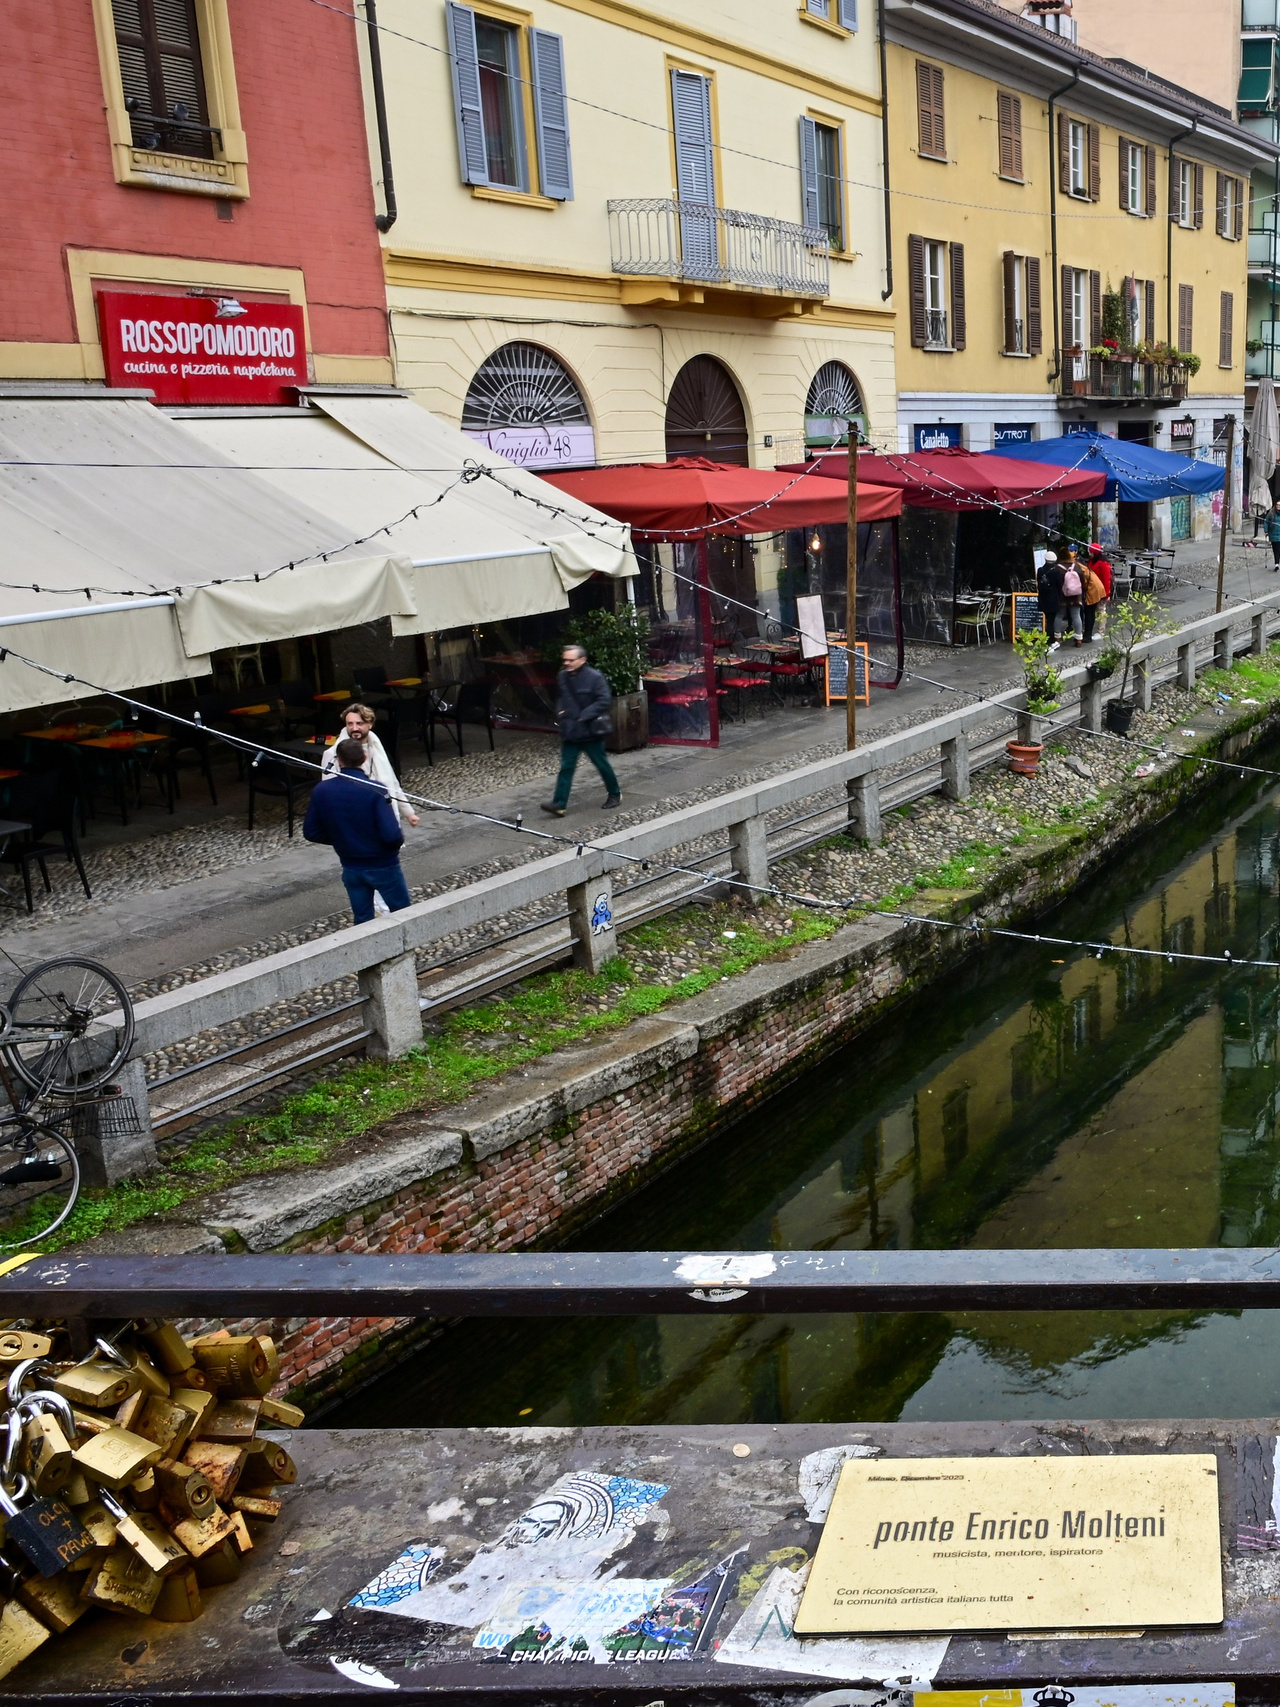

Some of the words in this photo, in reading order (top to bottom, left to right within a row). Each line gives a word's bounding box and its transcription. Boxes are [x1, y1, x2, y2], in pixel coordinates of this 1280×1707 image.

[120, 319, 295, 358] ROSSOPOMODORO
[124, 361, 168, 374] cucina
[171, 365, 178, 374] e
[181, 363, 230, 378] pizzeria
[233, 362, 296, 380] napoletana
[994, 430, 1027, 440] BISTROT
[1173, 423, 1193, 436] BANCO
[554, 435, 572, 459] 48
[920, 429, 949, 449] Canaletto
[873, 1516, 954, 1549] ponte
[965, 1511, 1049, 1541] Enrico
[1061, 1508, 1165, 1539] Molteni
[933, 1550, 991, 1558] musicista,
[995, 1550, 1046, 1558] mentore,
[1050, 1548, 1103, 1558] ispiratore
[837, 1588, 859, 1596] Con
[863, 1587, 938, 1596] riconoscenza,
[833, 1598, 843, 1606] la
[847, 1597, 897, 1605] comunità
[901, 1596, 944, 1604] artistica
[947, 1595, 986, 1603] italiana
